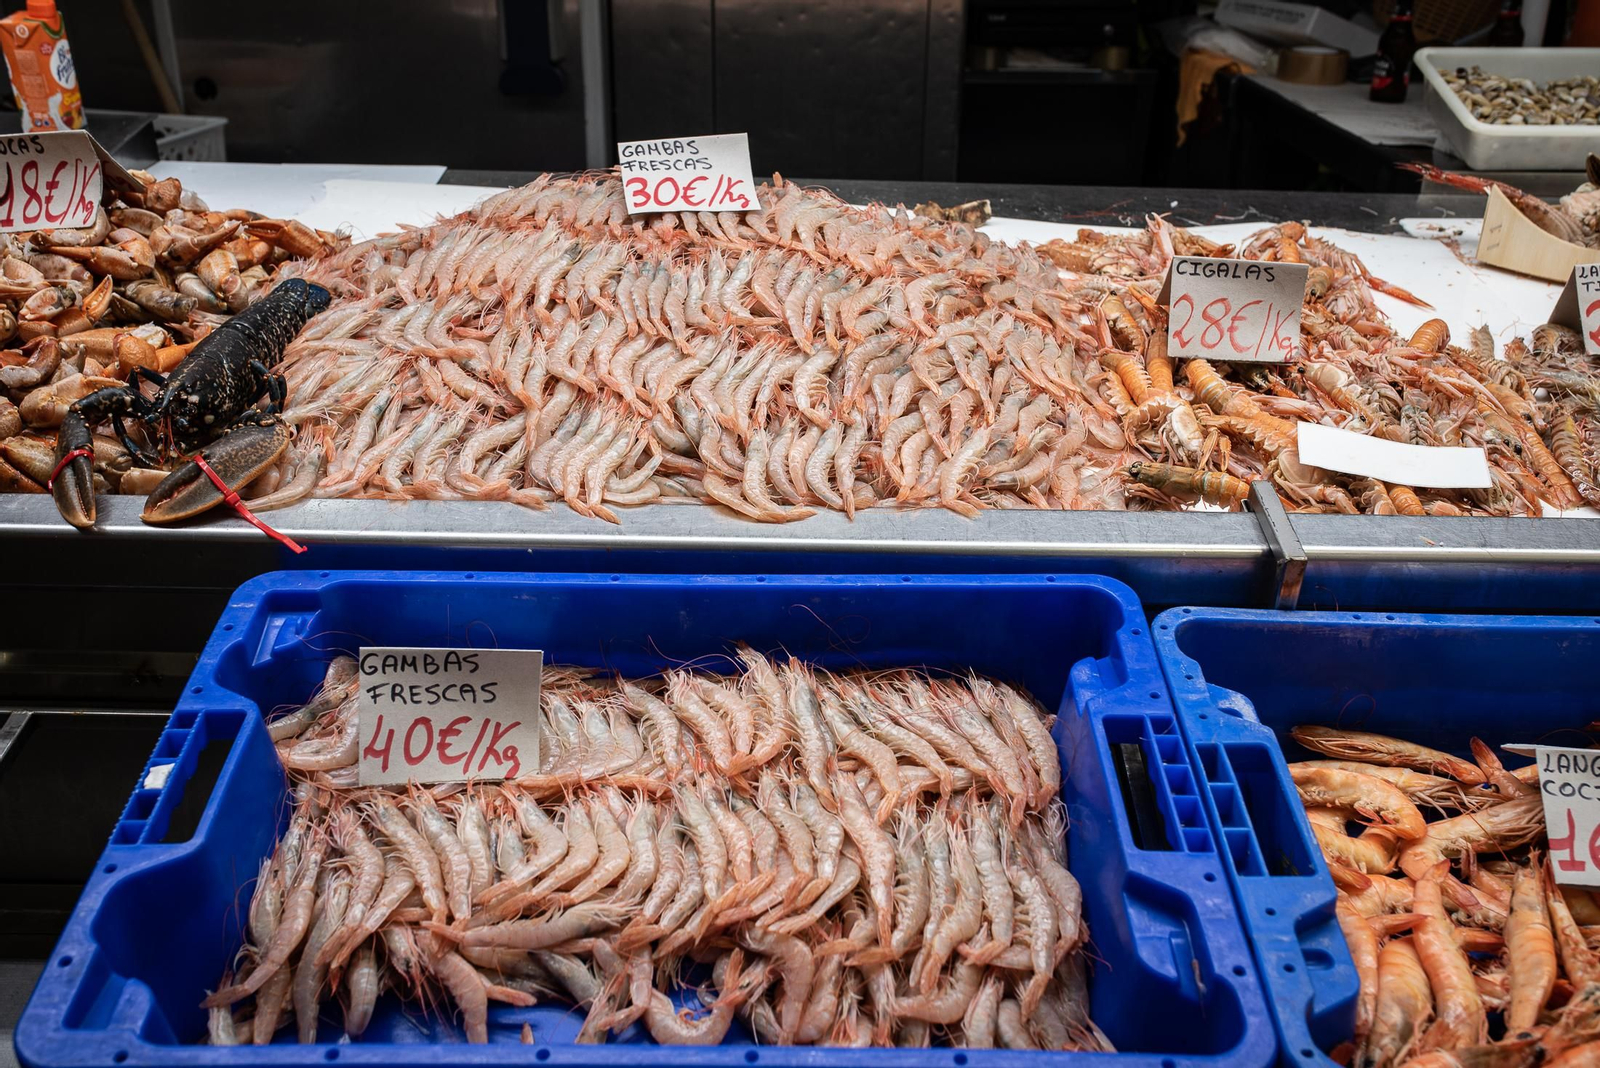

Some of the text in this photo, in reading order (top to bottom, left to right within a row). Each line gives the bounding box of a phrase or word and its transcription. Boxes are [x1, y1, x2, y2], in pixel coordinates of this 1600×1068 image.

[622, 140, 700, 158] GAMBAS
[621, 157, 713, 172] FRESCAS
[625, 174, 750, 209] 30€/Kg
[1176, 260, 1275, 282] CIGALAS
[1172, 293, 1299, 362] 28€/Kg
[360, 651, 480, 676] GAMBAS
[366, 682, 498, 705] FRESCAS
[363, 714, 522, 779] 40€/Kg
